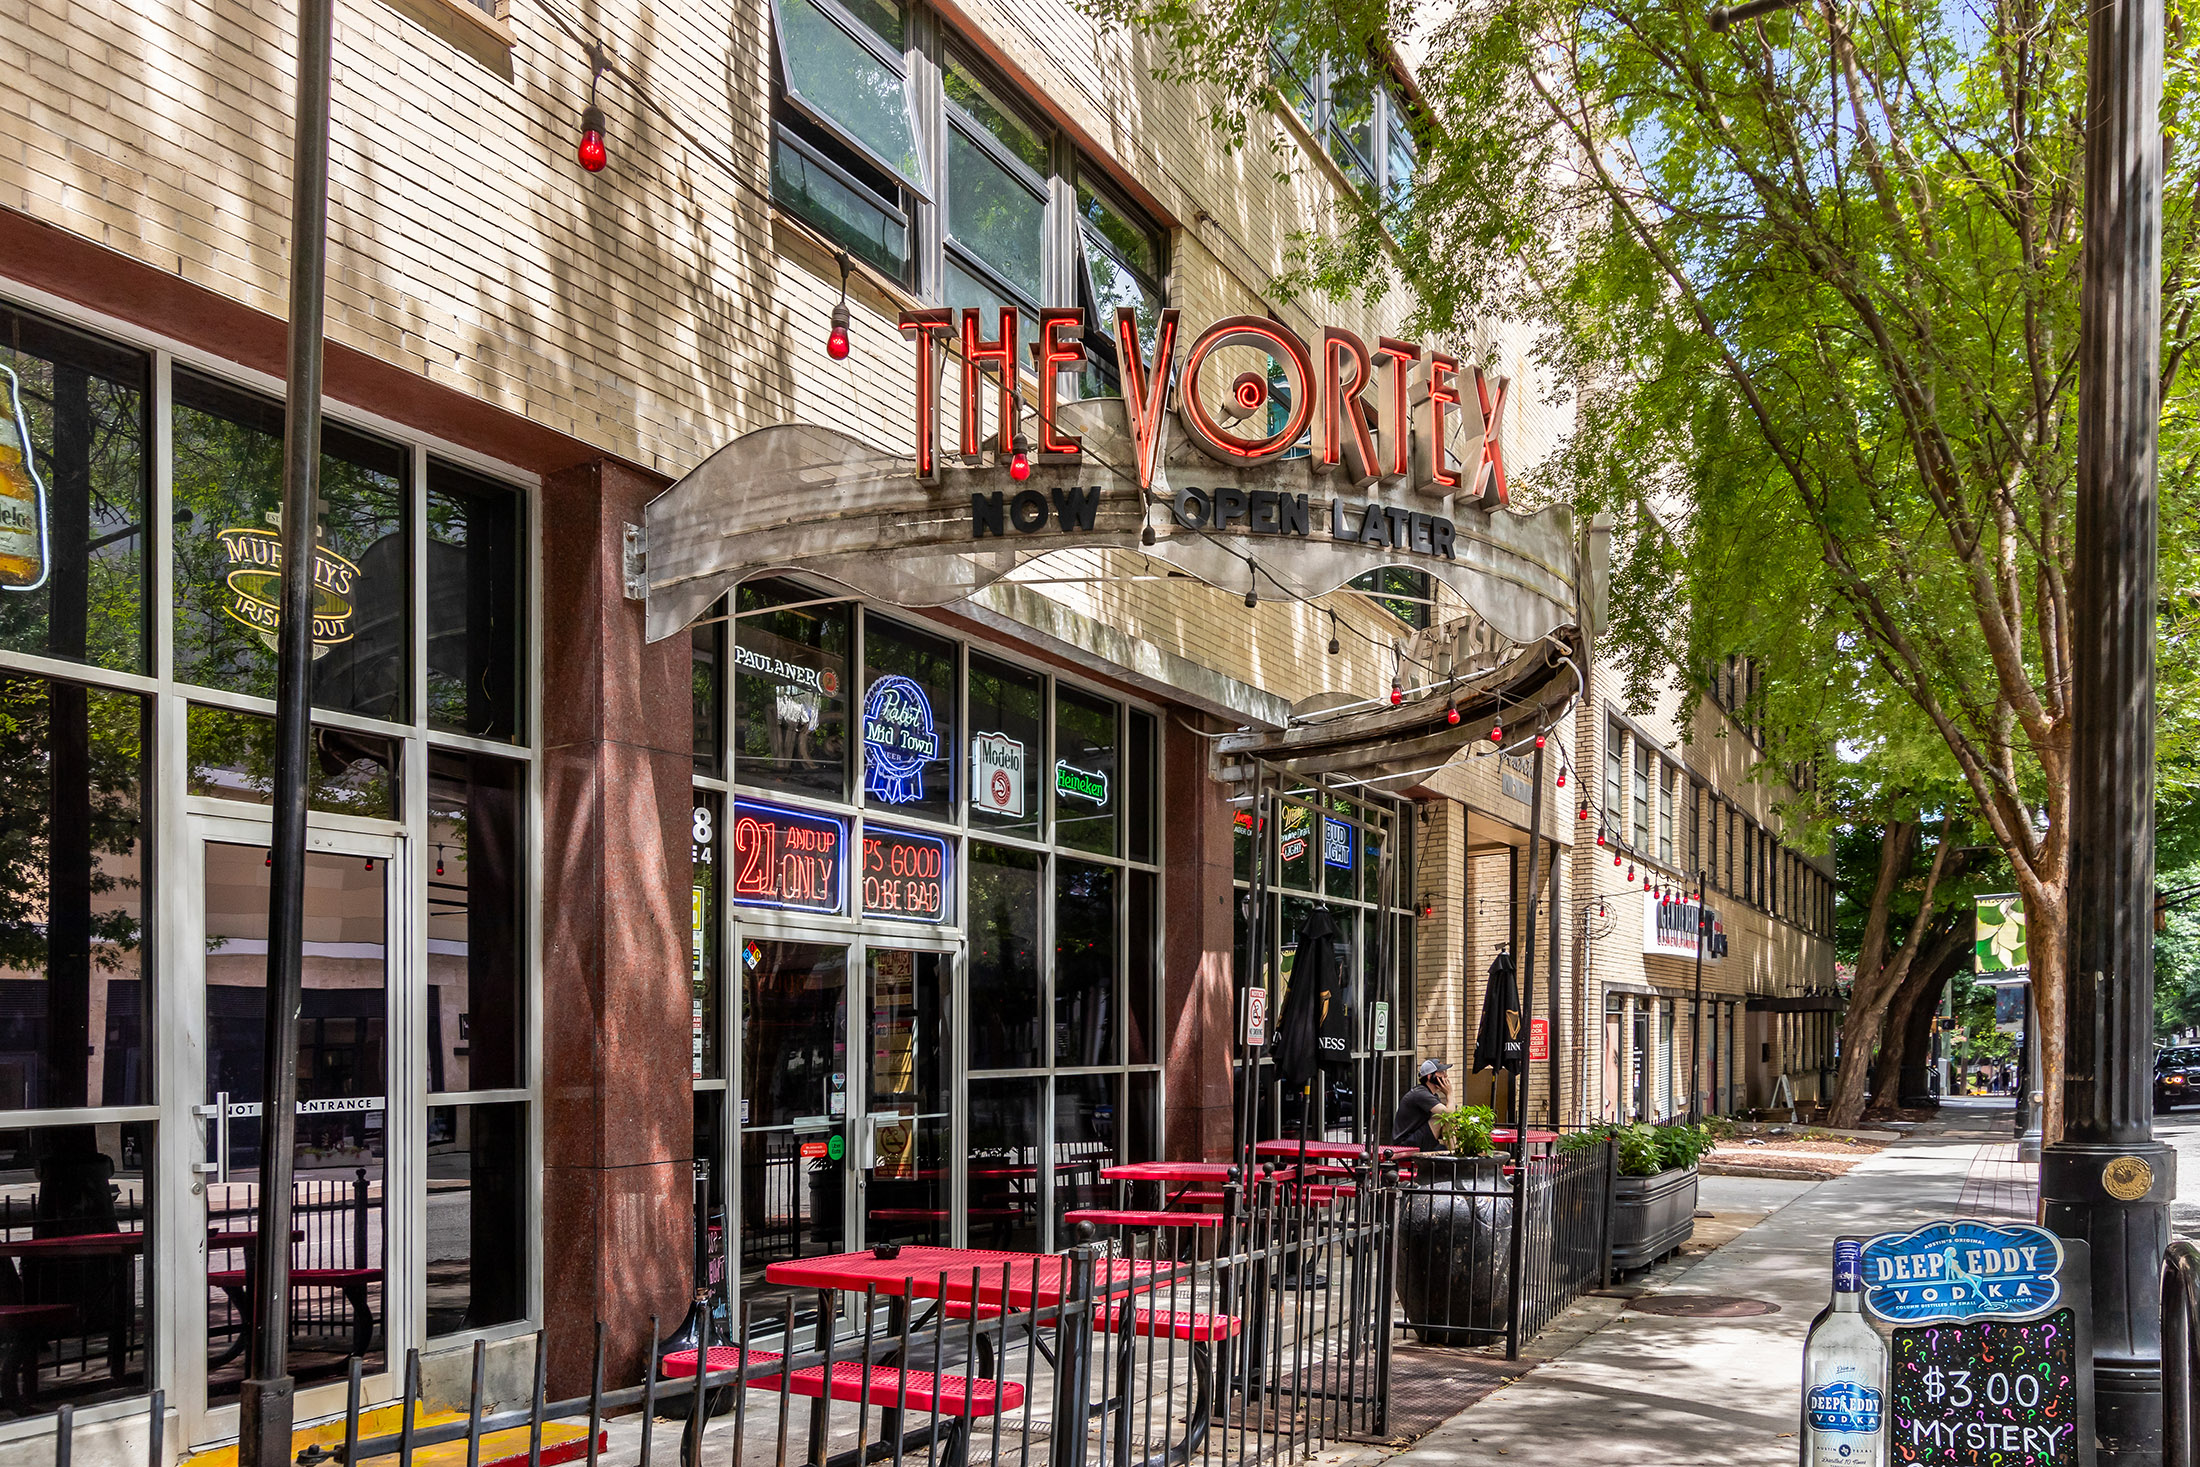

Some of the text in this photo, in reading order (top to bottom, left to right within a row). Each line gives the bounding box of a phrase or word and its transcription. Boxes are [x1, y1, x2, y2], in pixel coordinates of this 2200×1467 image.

[898, 307, 1510, 514] THE VORTEX
[972, 486, 1456, 560] NOW OPEN LATER
[313, 620, 345, 637] OUT
[735, 645, 817, 688] PAULANER
[883, 689, 923, 728] Pabst
[866, 722, 934, 755] Mid Town
[982, 739, 1019, 771] Modelo
[1058, 769, 1103, 797] Heineken
[785, 826, 835, 853] AND UP
[1325, 822, 1346, 845] BUD
[735, 817, 777, 895] 21
[891, 844, 942, 879] GOOD
[1285, 843, 1302, 857] LIGHT
[782, 854, 833, 900] ONLY
[881, 878, 901, 911] BE
[907, 881, 941, 913] BAD
[1319, 1036, 1346, 1051] NESS
[301, 1099, 372, 1112] ENTRANCE
[1924, 1237, 1985, 1249] AUSTIN'S ORIGINAL
[1876, 1246, 2038, 1281] DEEP EDDY
[1894, 1282, 2032, 1303] VODKA
[1922, 1365, 2040, 1408] $3.00
[1811, 1396, 1880, 1412] DEEP EDDY
[1816, 1414, 1876, 1424] VODKA
[1913, 1418, 2064, 1457] MYSTERY
